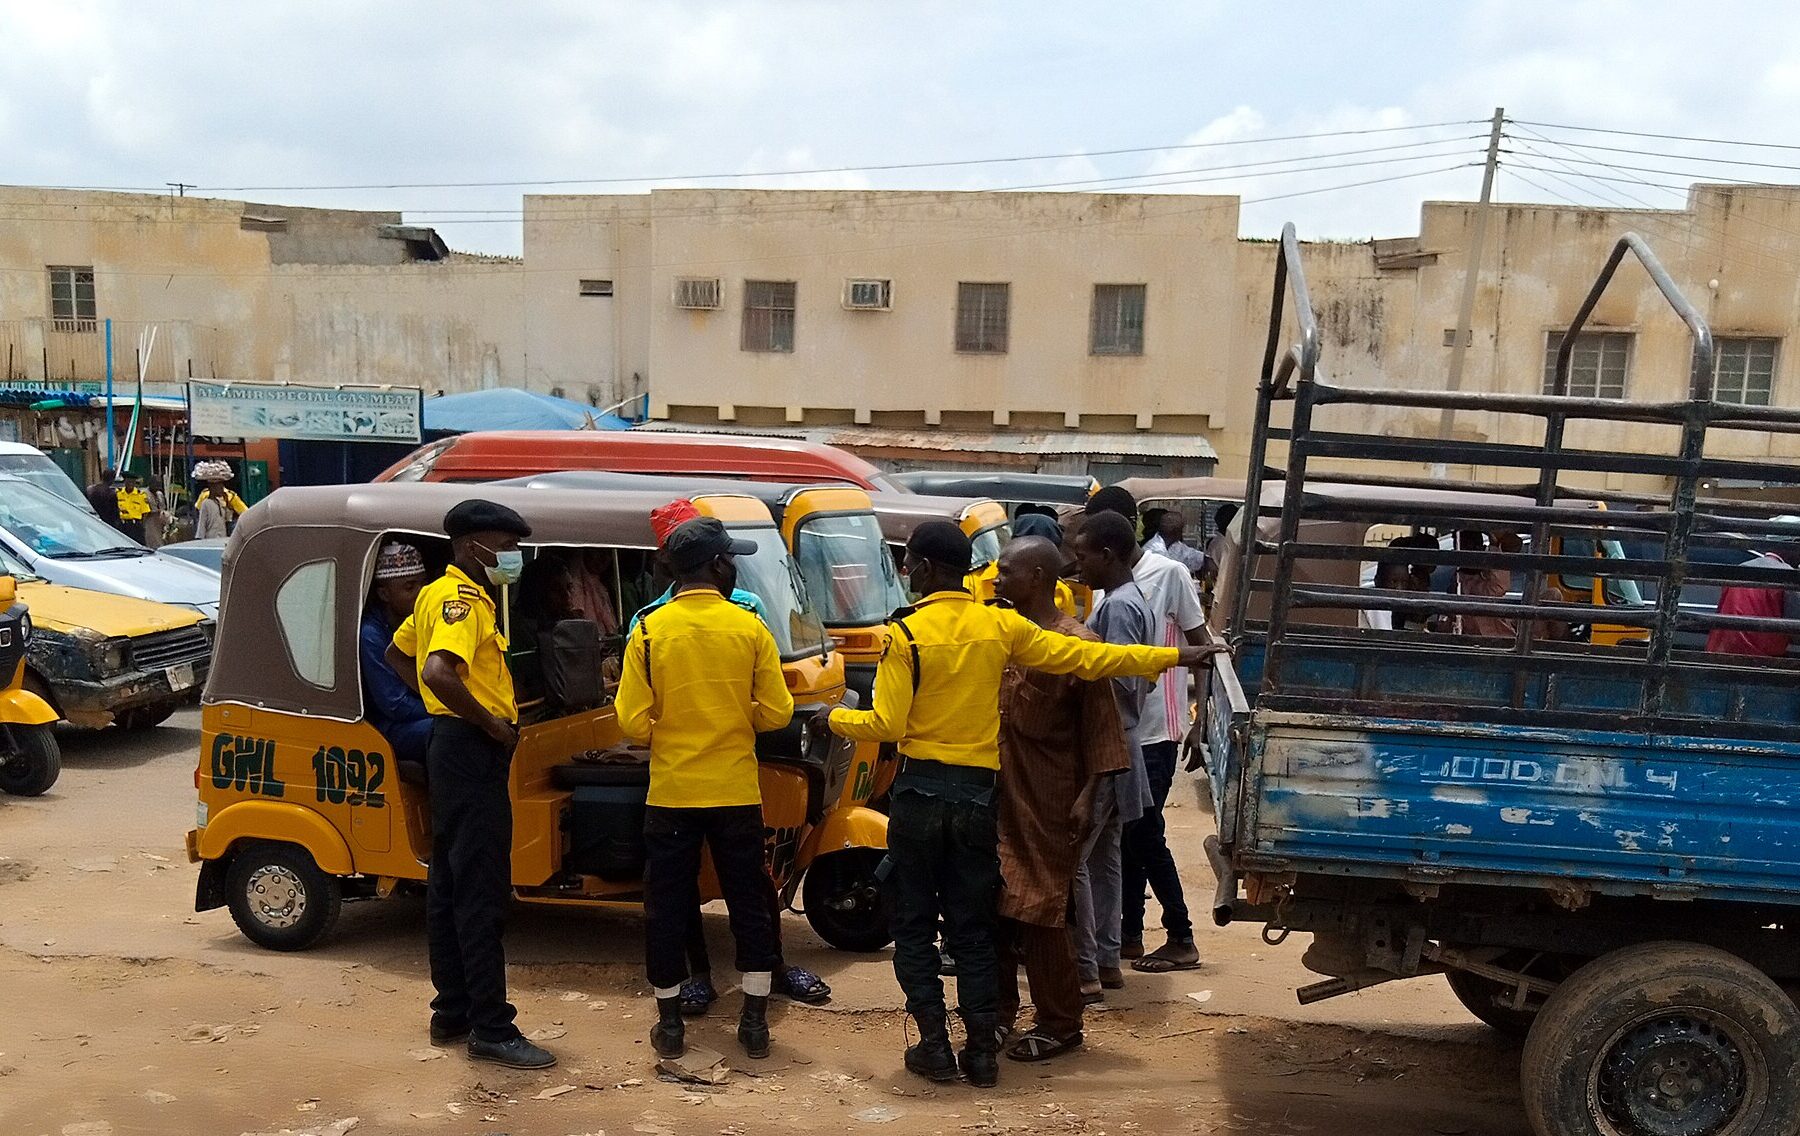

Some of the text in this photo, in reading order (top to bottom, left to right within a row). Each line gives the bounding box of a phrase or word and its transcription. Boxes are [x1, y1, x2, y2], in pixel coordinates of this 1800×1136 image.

[268, 390, 333, 402] SPECIAL
[337, 392, 368, 403] GAS
[370, 393, 415, 405] MEAT
[312, 745, 385, 809] 1092
